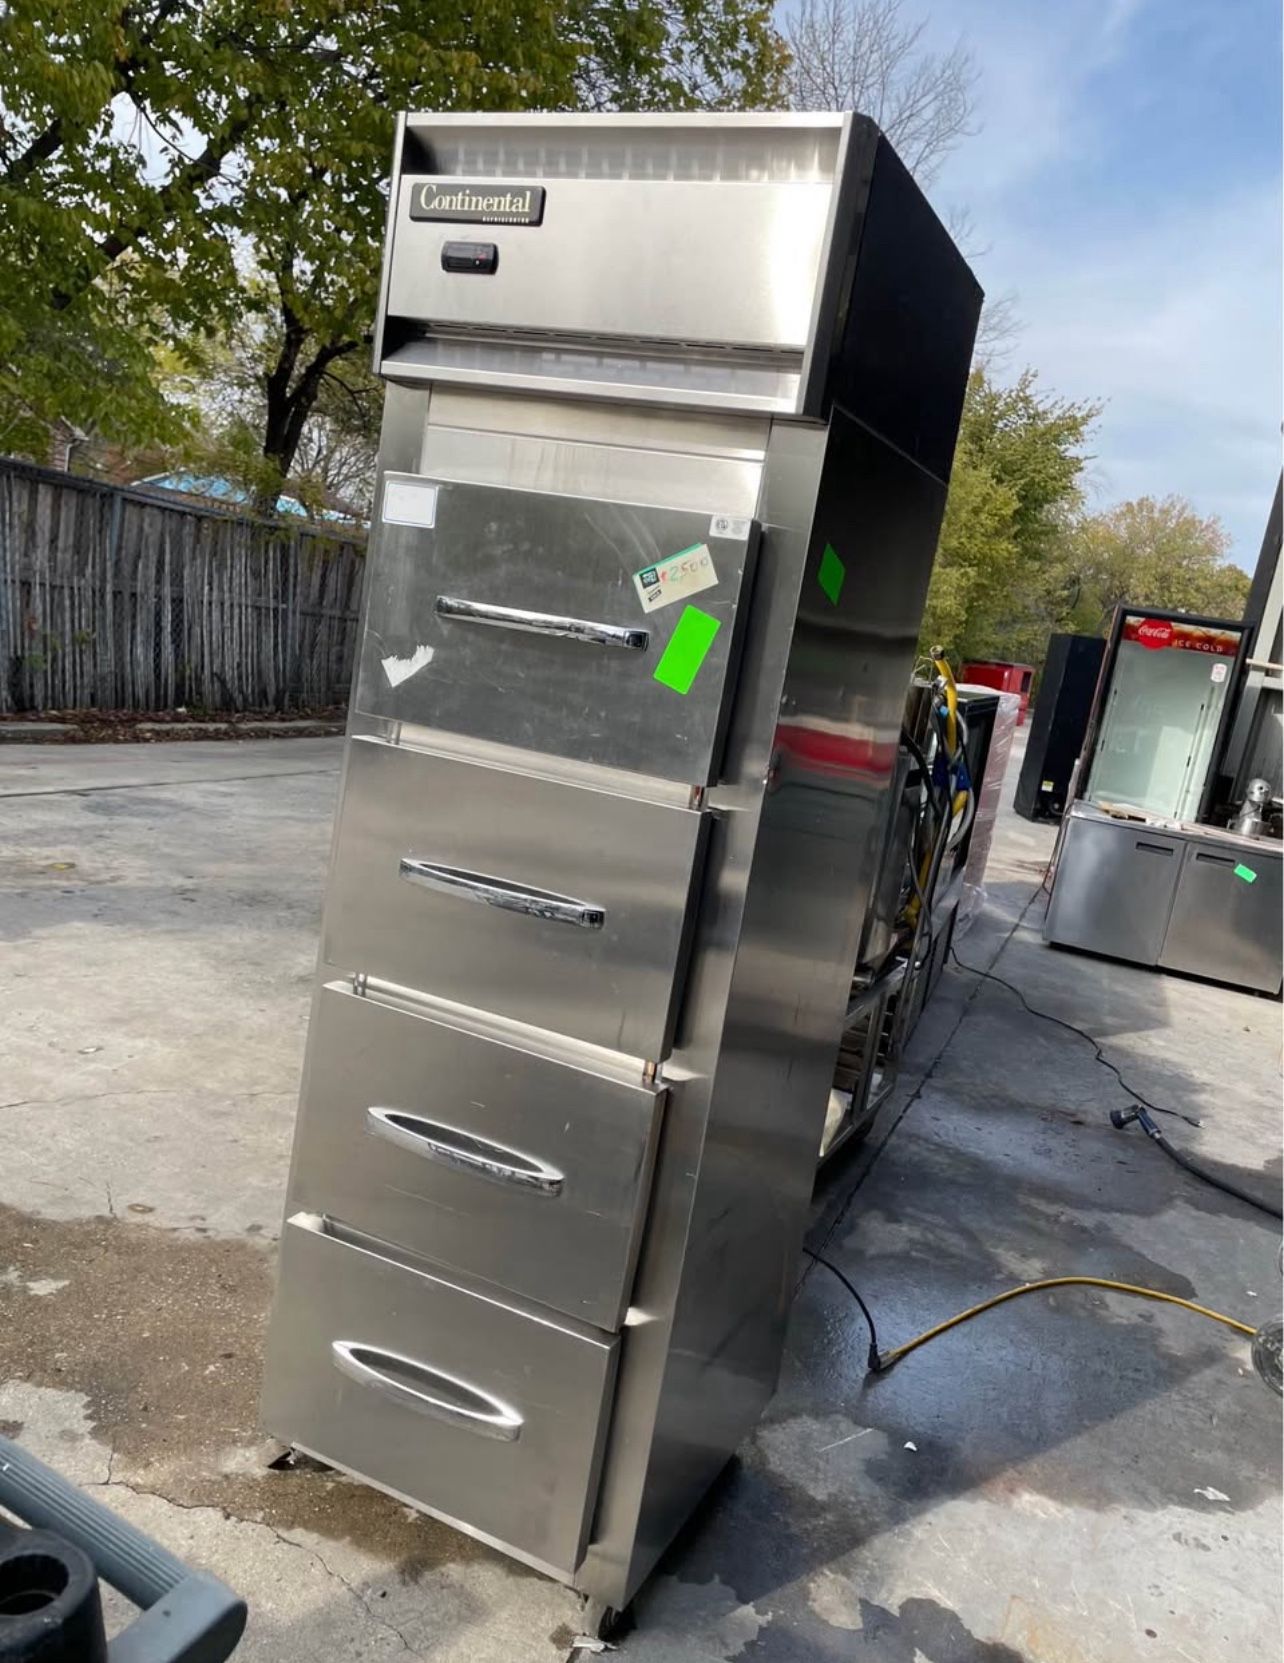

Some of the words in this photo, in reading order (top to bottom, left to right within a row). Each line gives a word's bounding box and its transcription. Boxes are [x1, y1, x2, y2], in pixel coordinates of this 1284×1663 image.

[420, 183, 531, 212] Continental
[1175, 639, 1192, 648] ICE
[1196, 642, 1223, 652] COLD
